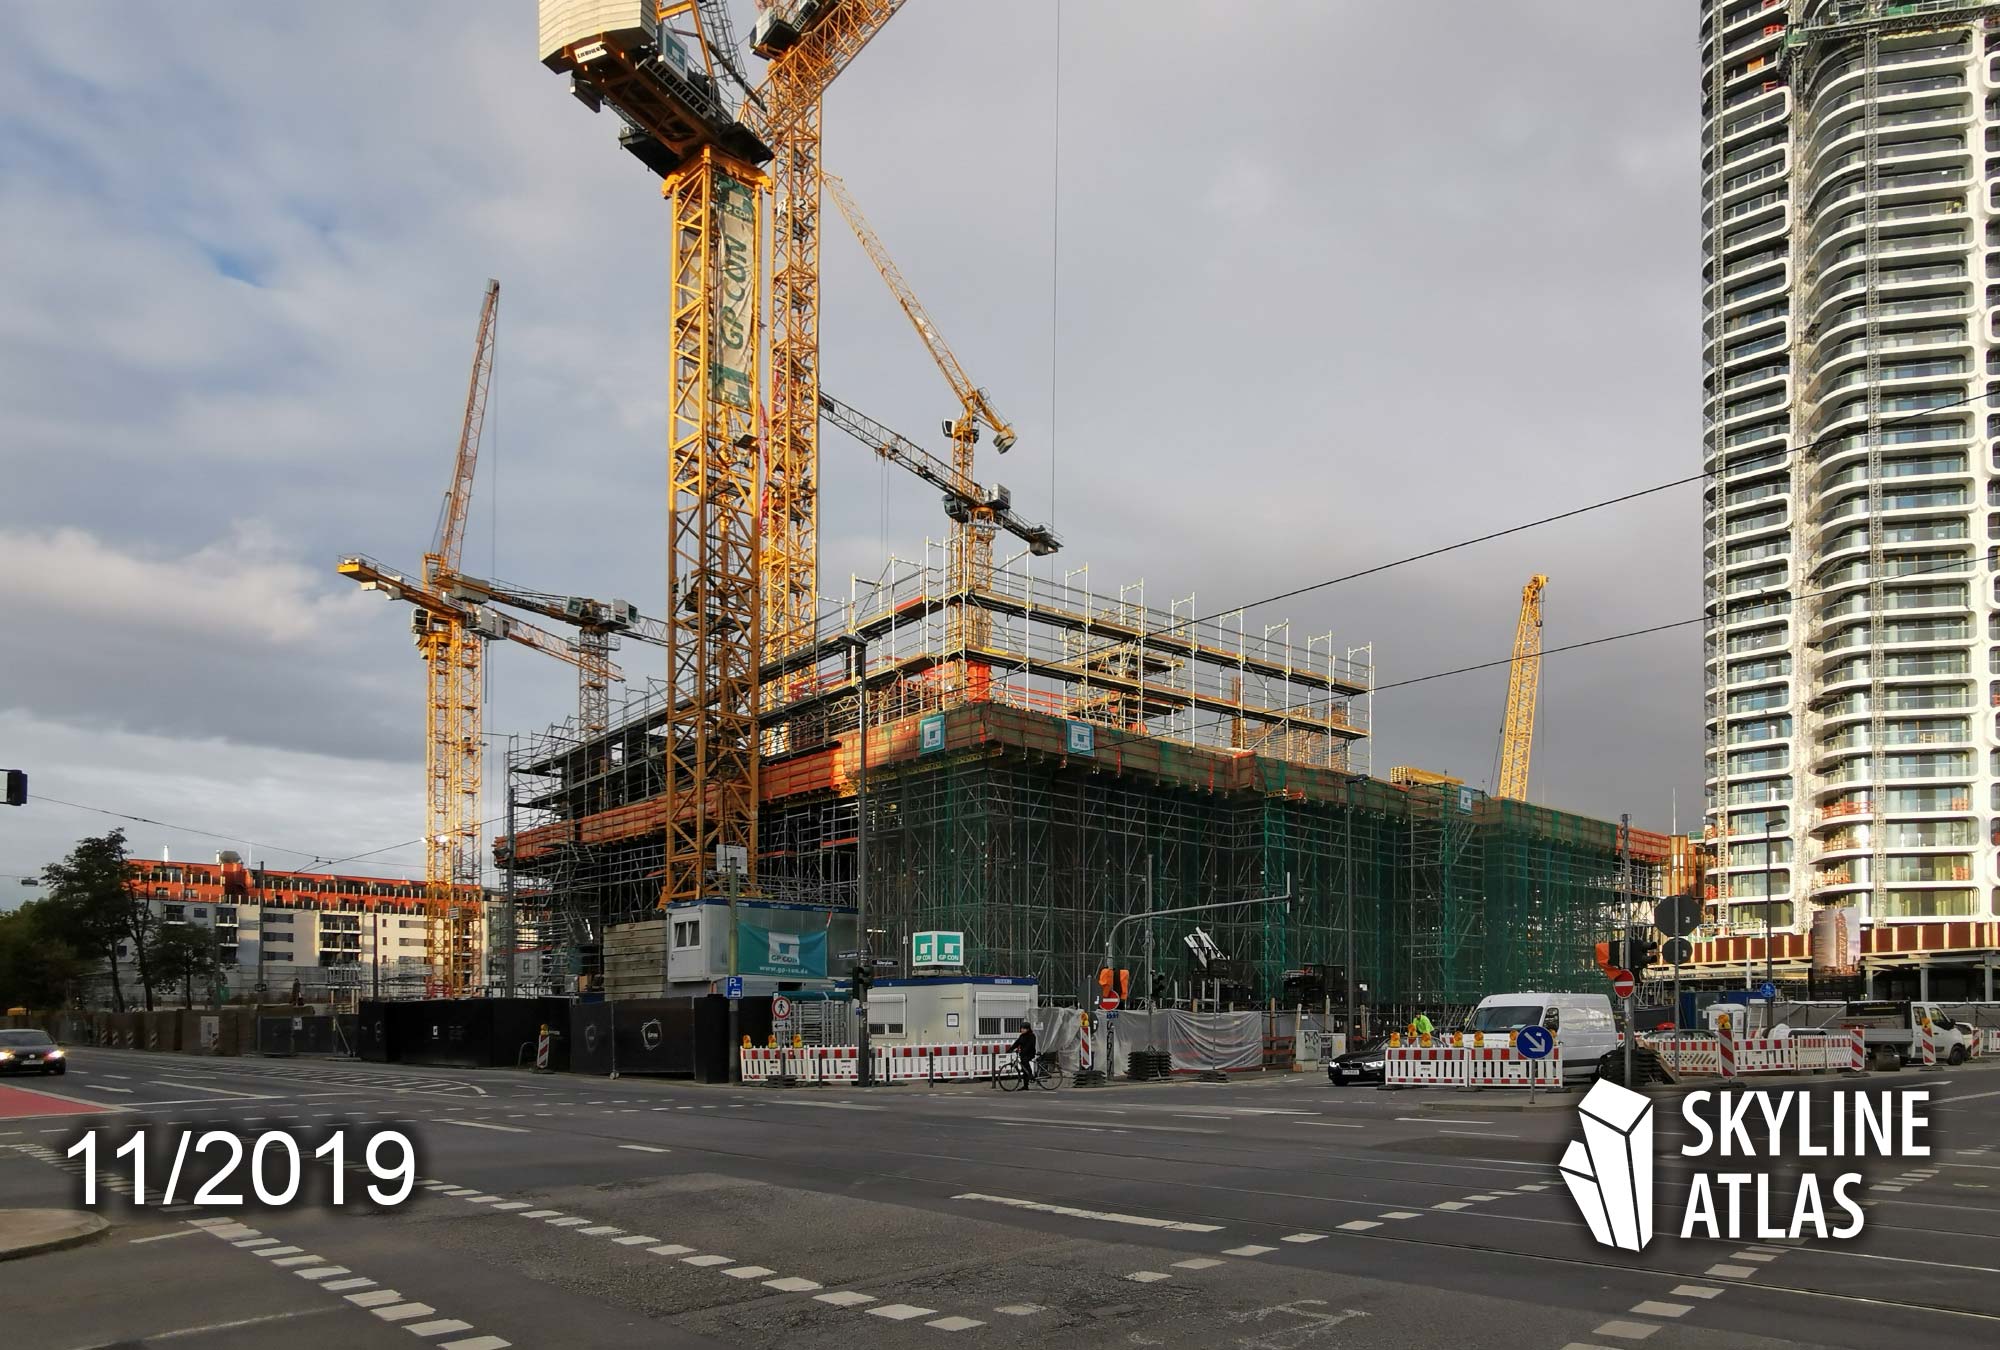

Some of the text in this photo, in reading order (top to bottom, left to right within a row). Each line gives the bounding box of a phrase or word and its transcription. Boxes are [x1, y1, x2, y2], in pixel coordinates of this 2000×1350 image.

[647, 58, 708, 116] LIEBHERR
[799, 198, 806, 210] 2
[719, 233, 747, 350] GP CON
[729, 978, 736, 987] P
